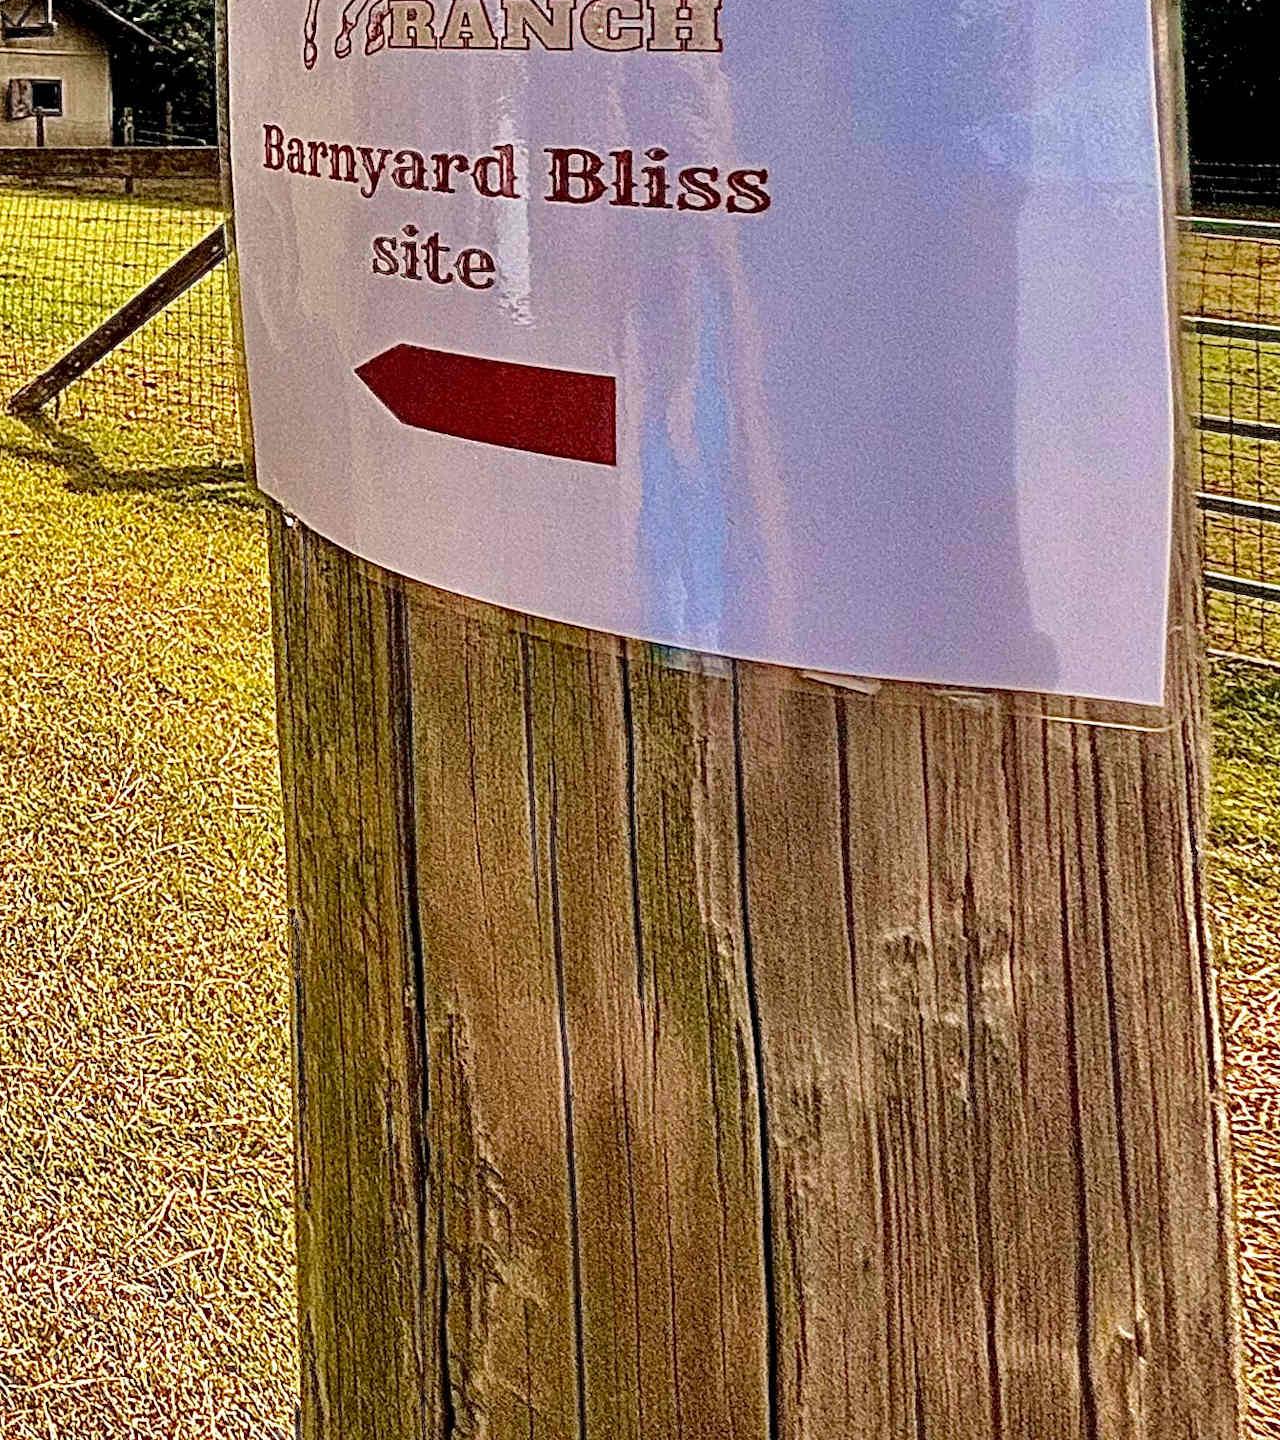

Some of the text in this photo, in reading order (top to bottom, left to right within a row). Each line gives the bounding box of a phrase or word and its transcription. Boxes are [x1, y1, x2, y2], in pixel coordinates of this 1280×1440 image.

[262, 124, 772, 215] Barnyard Bliss
[371, 224, 496, 290] site
